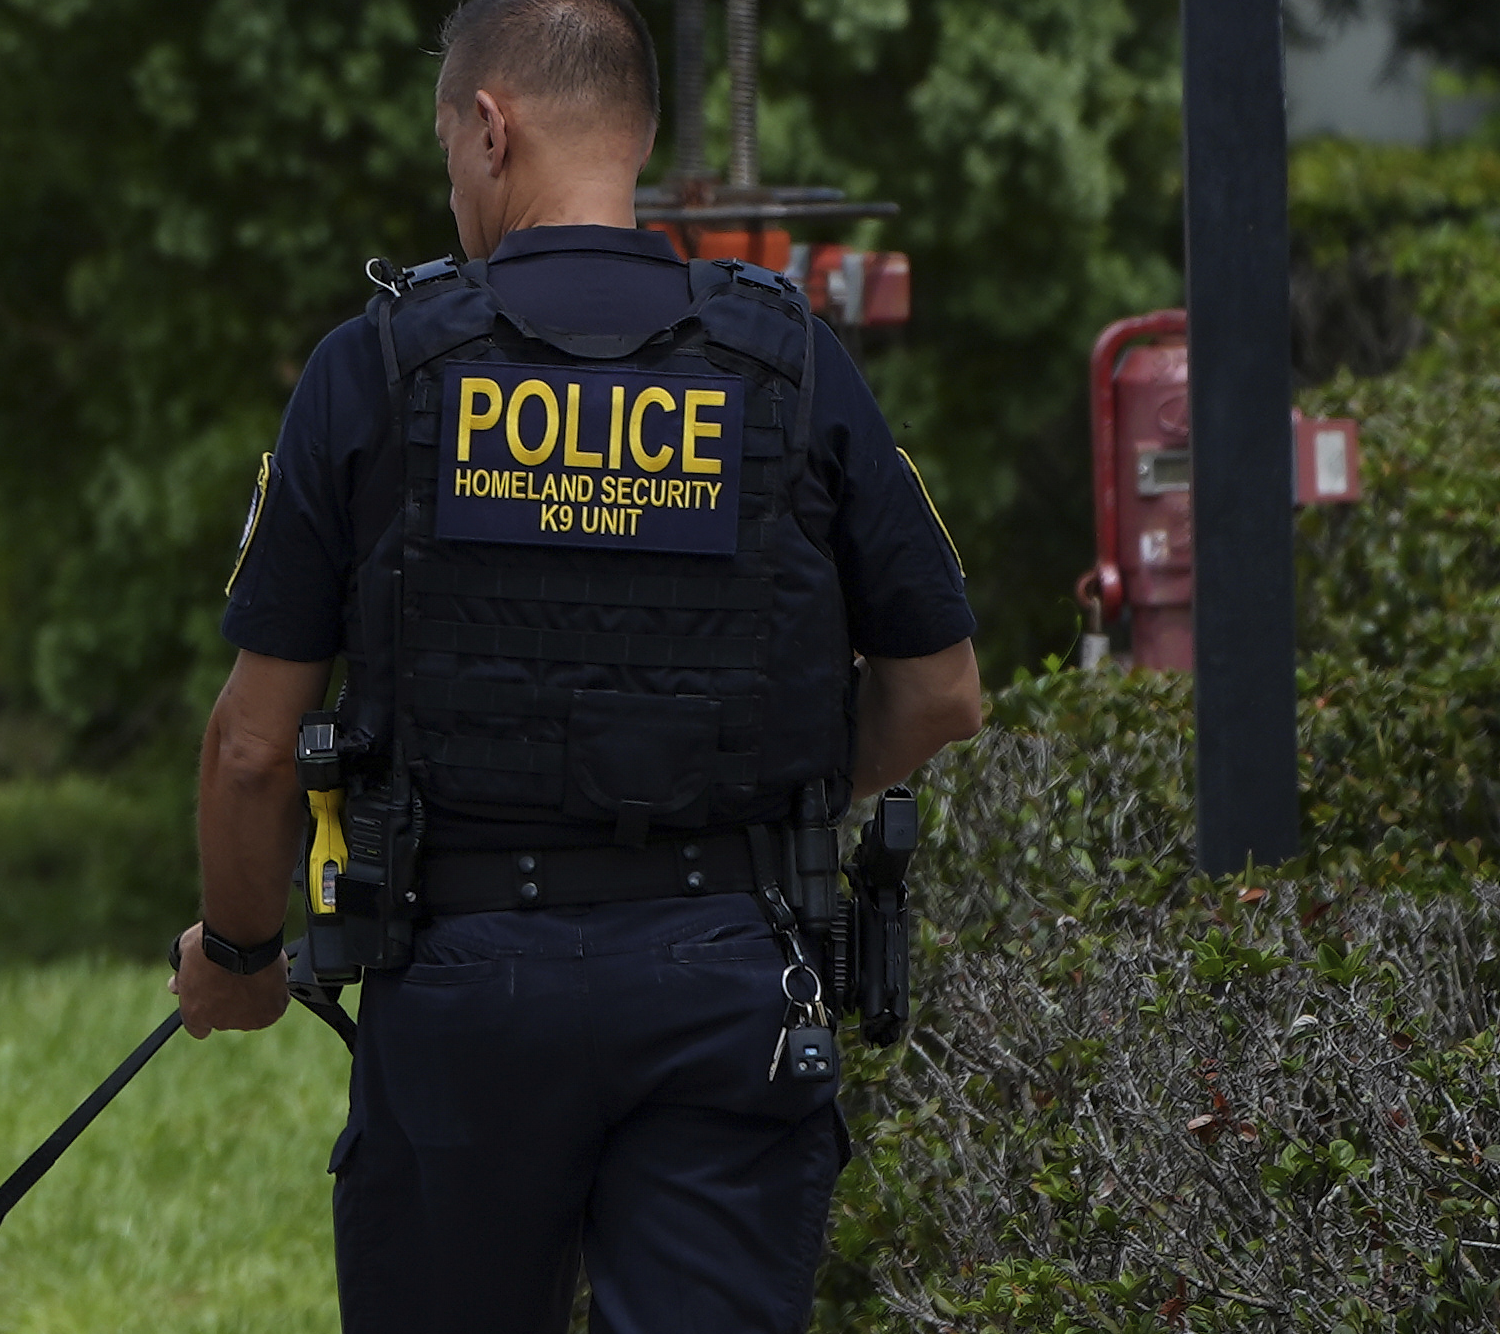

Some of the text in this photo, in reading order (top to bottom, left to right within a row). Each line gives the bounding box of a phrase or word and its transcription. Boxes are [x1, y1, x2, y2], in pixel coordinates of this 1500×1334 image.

[457, 377, 726, 475] POLICE
[454, 468, 723, 511] HOMELAND SECURITY
[539, 503, 644, 537] K9 UNIT
